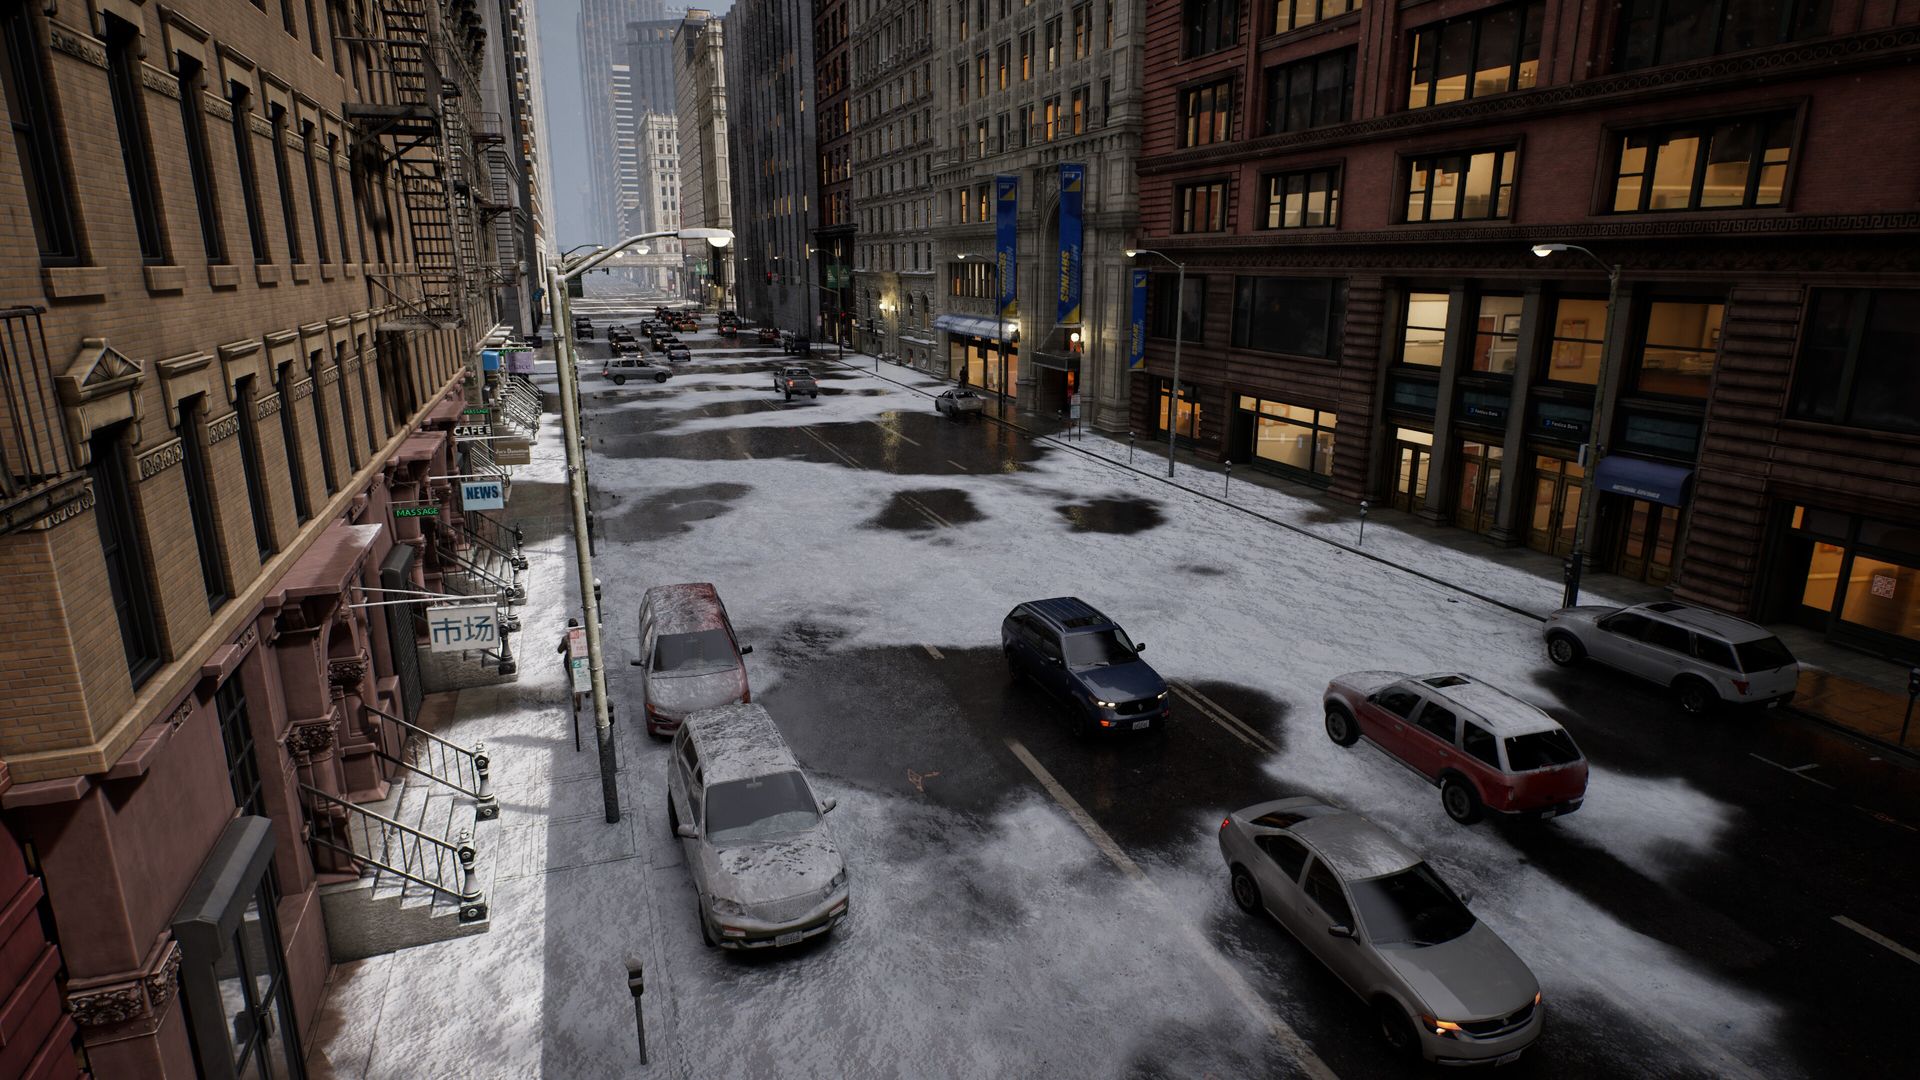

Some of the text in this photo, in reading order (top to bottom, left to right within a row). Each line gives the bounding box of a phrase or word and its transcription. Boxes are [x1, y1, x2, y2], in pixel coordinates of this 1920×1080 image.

[1060, 251, 1070, 302] SAVINGS
[453, 427, 483, 436] CAFE
[466, 486, 498, 500] NEWS
[396, 508, 439, 516] MASSAGE
[431, 616, 494, 645] 市场
